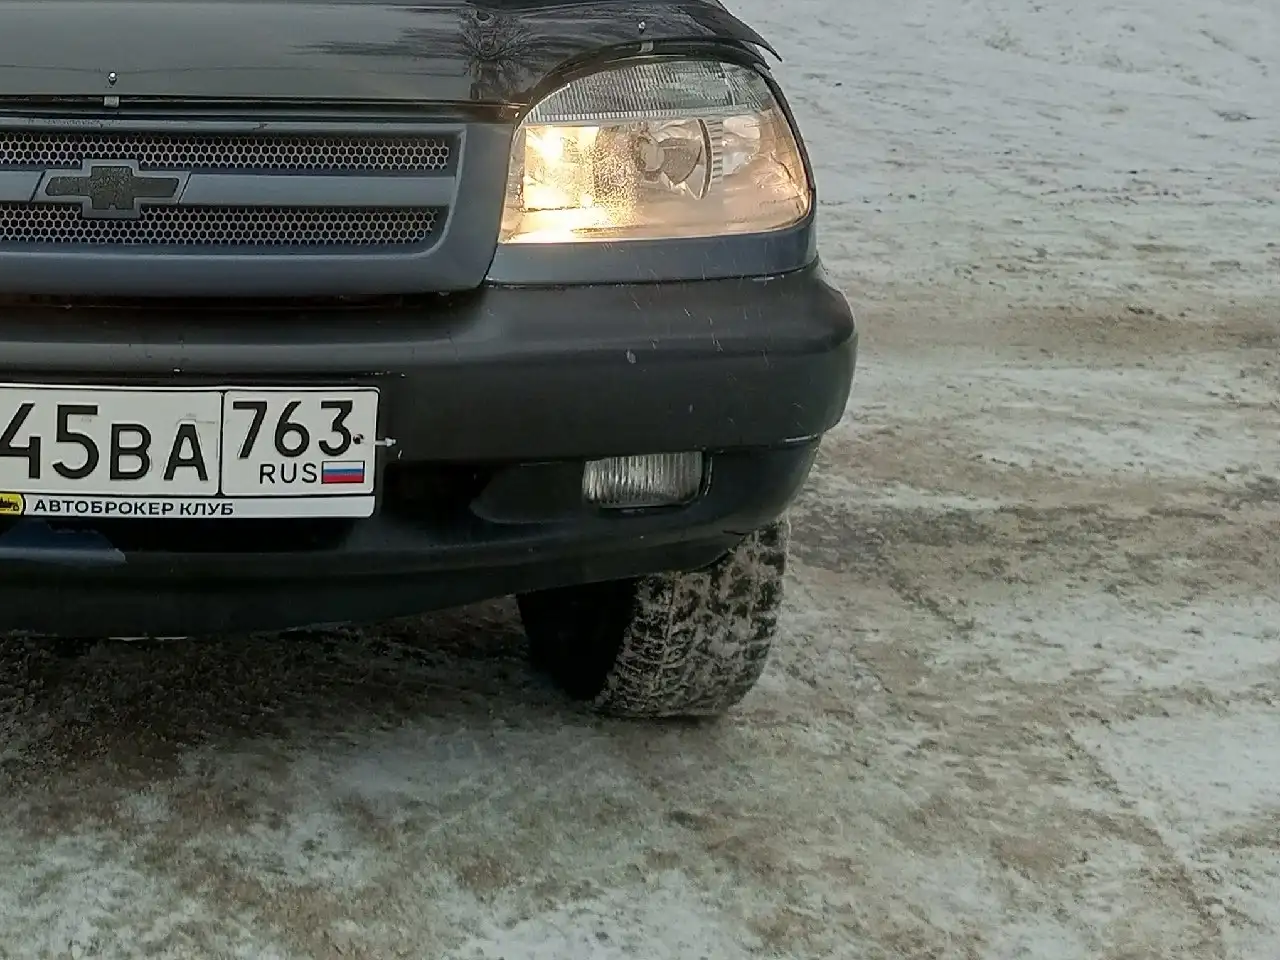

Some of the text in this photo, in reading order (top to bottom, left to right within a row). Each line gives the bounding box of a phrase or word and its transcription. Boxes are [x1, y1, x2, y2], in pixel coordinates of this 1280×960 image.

[232, 400, 353, 458] 763
[259, 463, 317, 484] RUS
[33, 499, 234, 517] АВТОБРОКЕР КЛУБ
